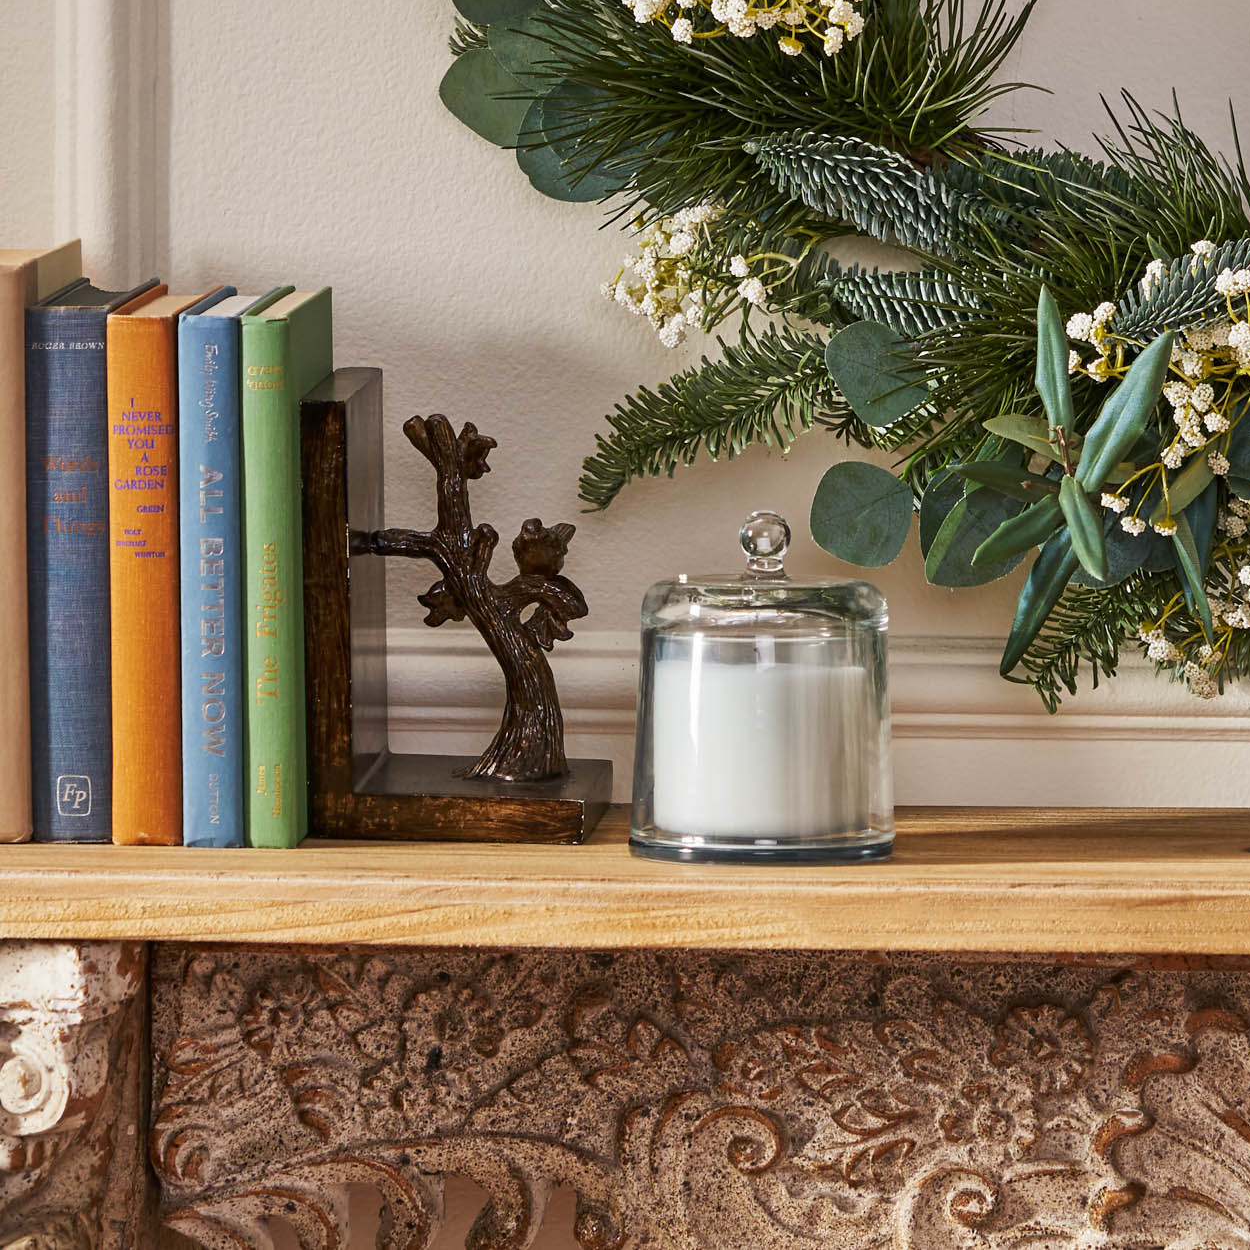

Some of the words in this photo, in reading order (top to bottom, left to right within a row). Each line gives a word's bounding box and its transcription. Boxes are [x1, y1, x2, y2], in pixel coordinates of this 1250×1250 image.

[69, 342, 105, 350] BROWN
[130, 397, 135, 408] I
[121, 411, 162, 421] NEVER
[113, 424, 174, 435] PROMISED
[127, 438, 155, 449] YOU
[42, 456, 99, 472] Words
[140, 452, 149, 462] A
[135, 465, 167, 476] ROSE
[114, 478, 164, 490] GARDEN
[53, 486, 87, 502] and
[199, 464, 224, 522] ALL
[136, 504, 164, 513] GREEN
[42, 517, 104, 536] Things
[255, 542, 286, 638] Frigates
[199, 538, 225, 658] BETTER
[256, 656, 279, 705] The
[201, 672, 226, 758] NOW
[208, 773, 220, 824] DUTTON
